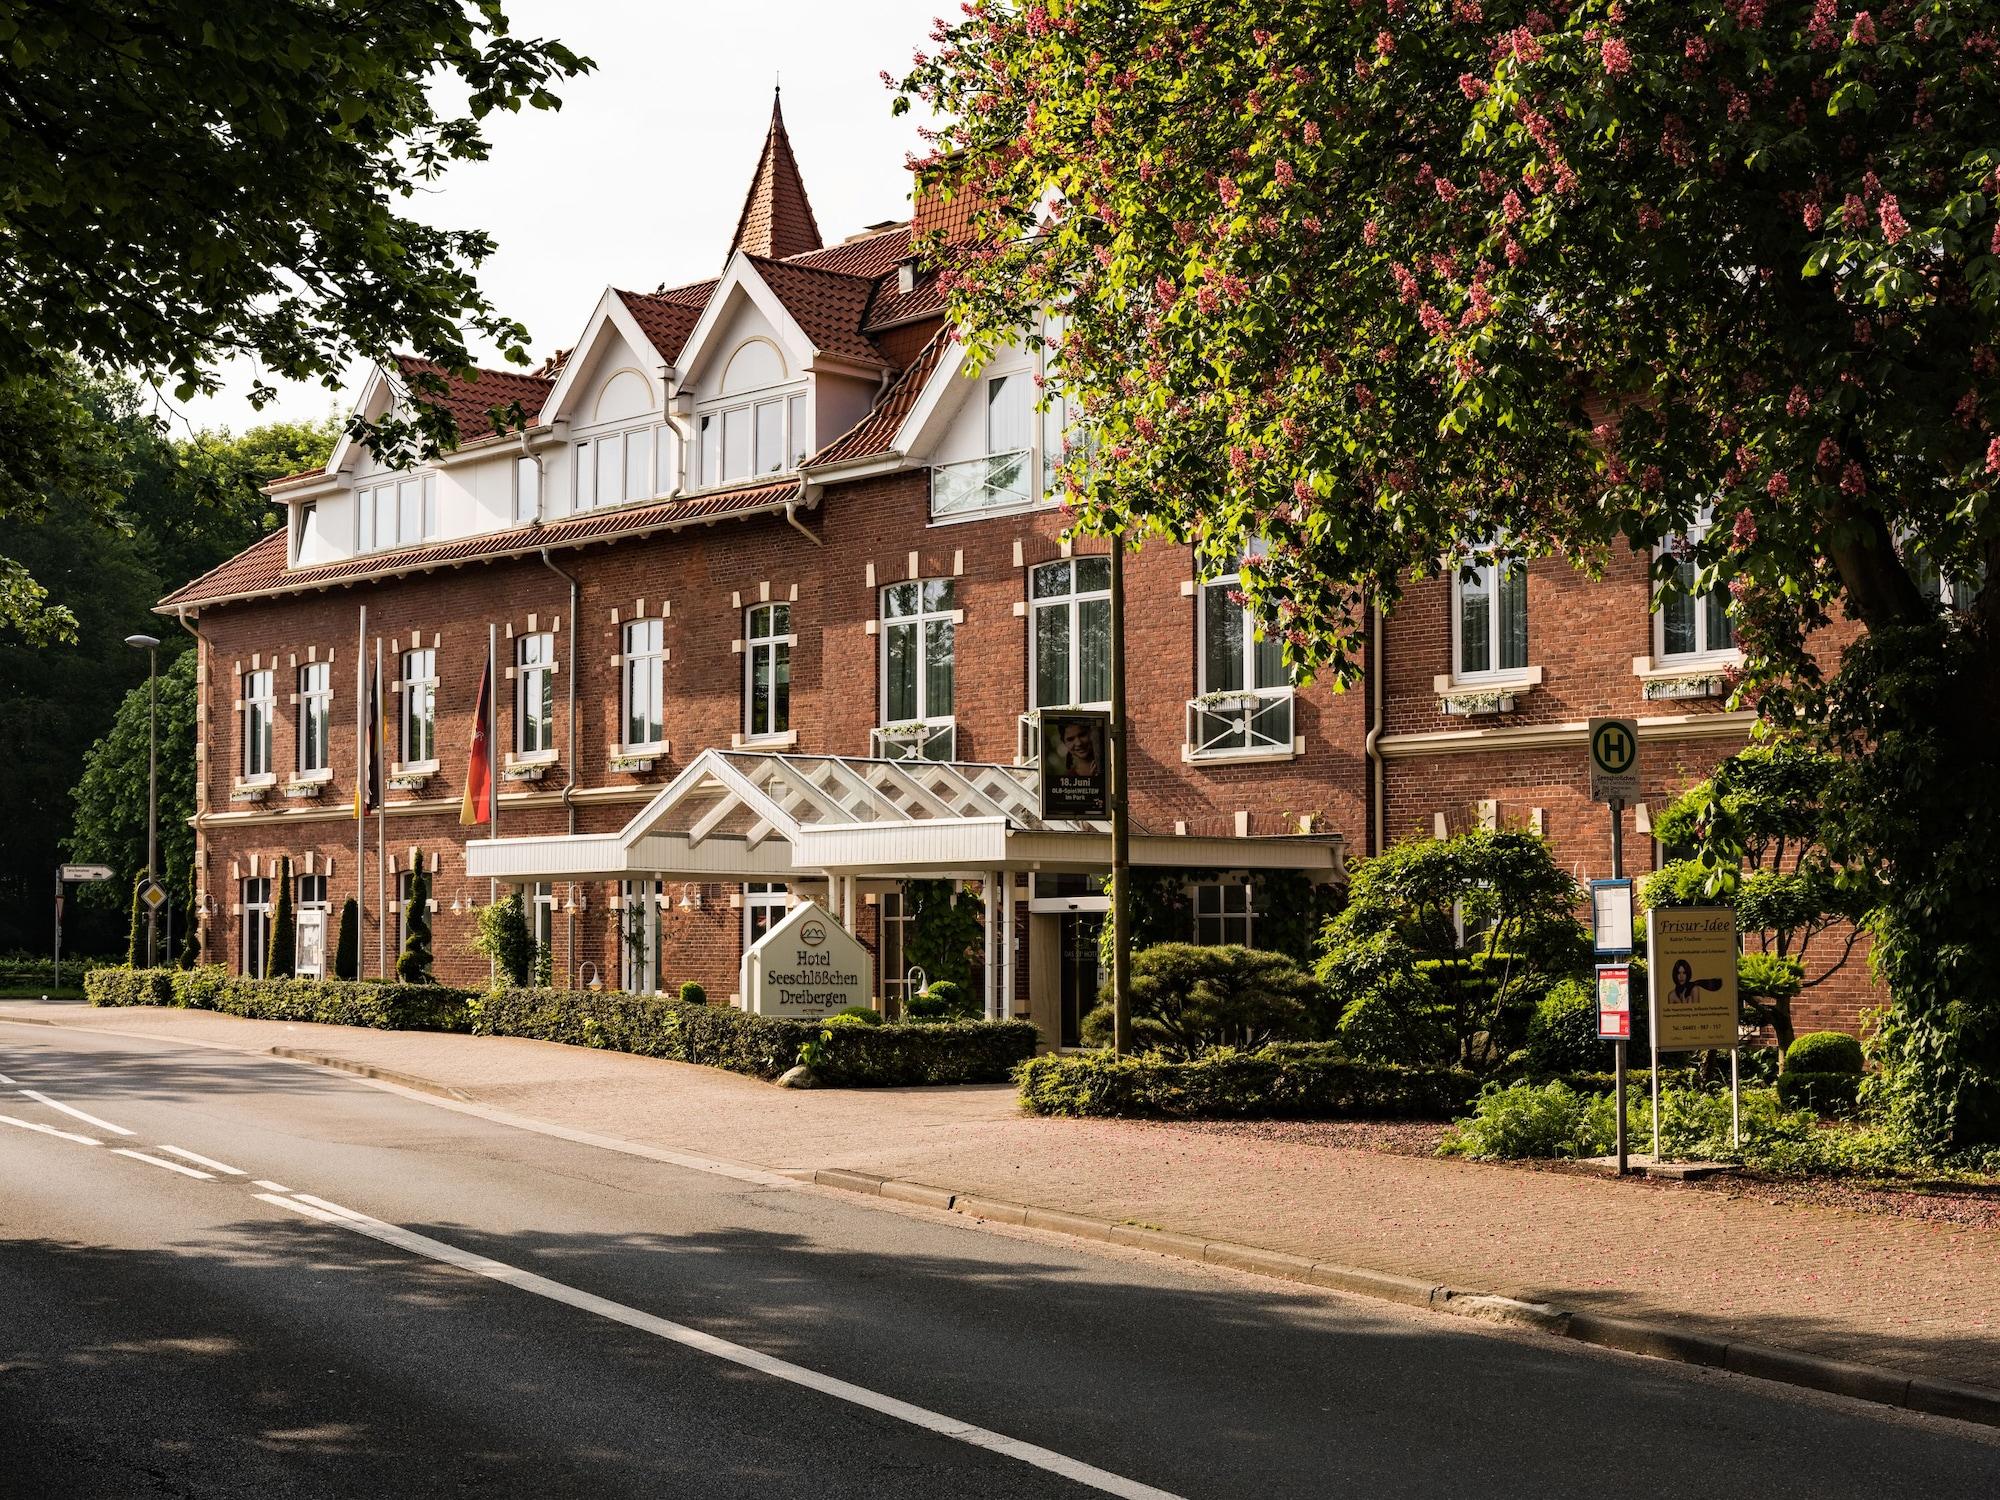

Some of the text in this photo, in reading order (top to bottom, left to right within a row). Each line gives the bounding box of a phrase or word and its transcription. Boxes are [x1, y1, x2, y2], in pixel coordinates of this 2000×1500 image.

[1604, 734, 1625, 762] H
[1060, 778, 1091, 786] 18. Juni
[1658, 918, 1730, 934] Frisur-Idee
[796, 951, 830, 965] Hotel
[768, 970, 858, 985] Seeschlößchen
[780, 989, 848, 1008] Dreibergen
